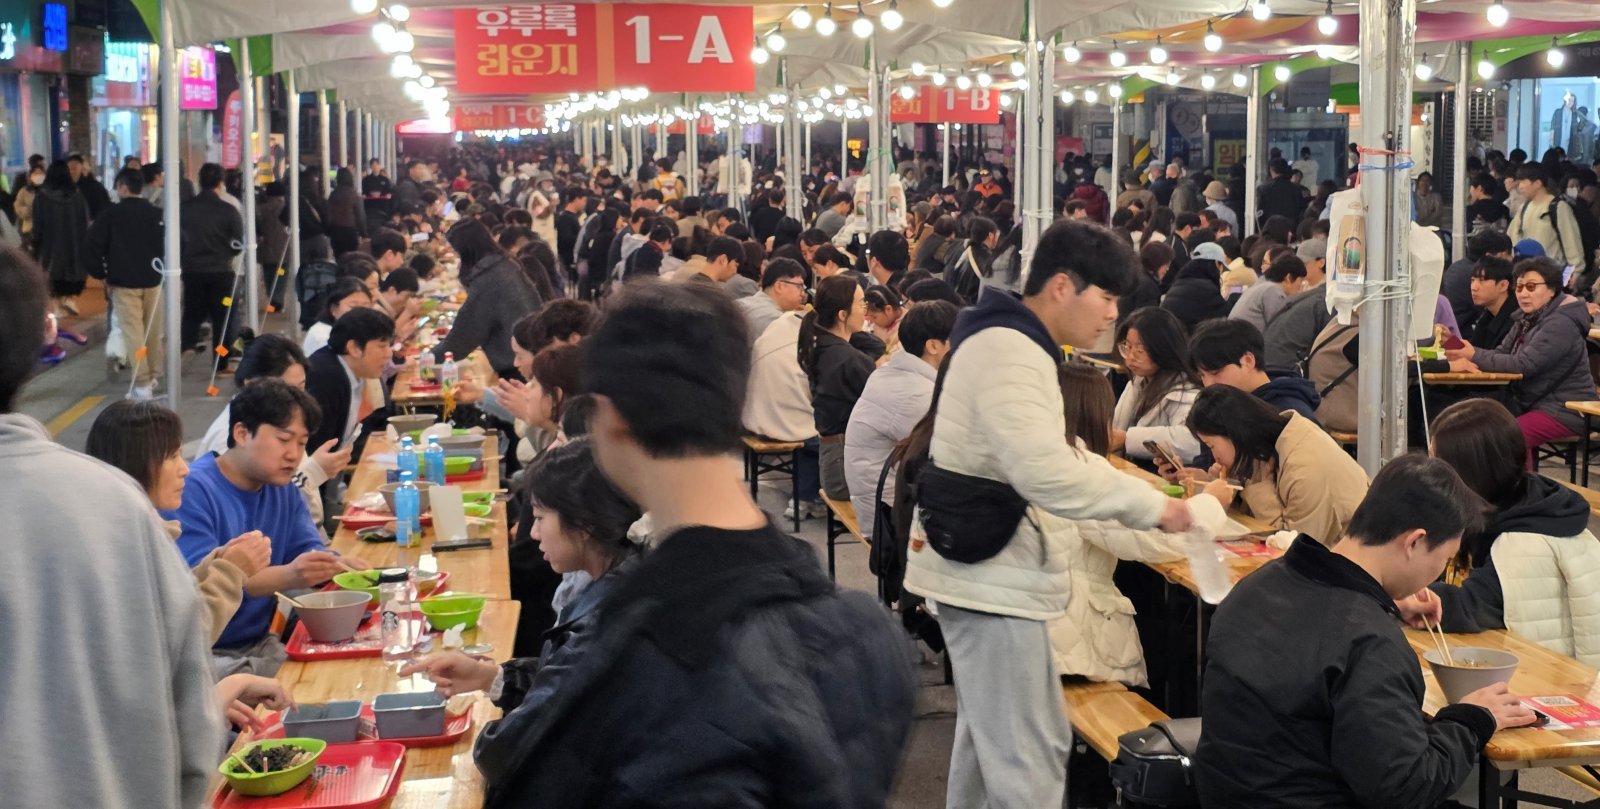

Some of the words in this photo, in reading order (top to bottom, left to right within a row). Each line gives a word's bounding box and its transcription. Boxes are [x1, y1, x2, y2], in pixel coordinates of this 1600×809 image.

[476, 4, 578, 37] 후루룩
[625, 15, 734, 64] 1-A
[477, 43, 578, 76] 라운지
[507, 106, 541, 123] 1-C
[943, 88, 991, 111] 1-B
